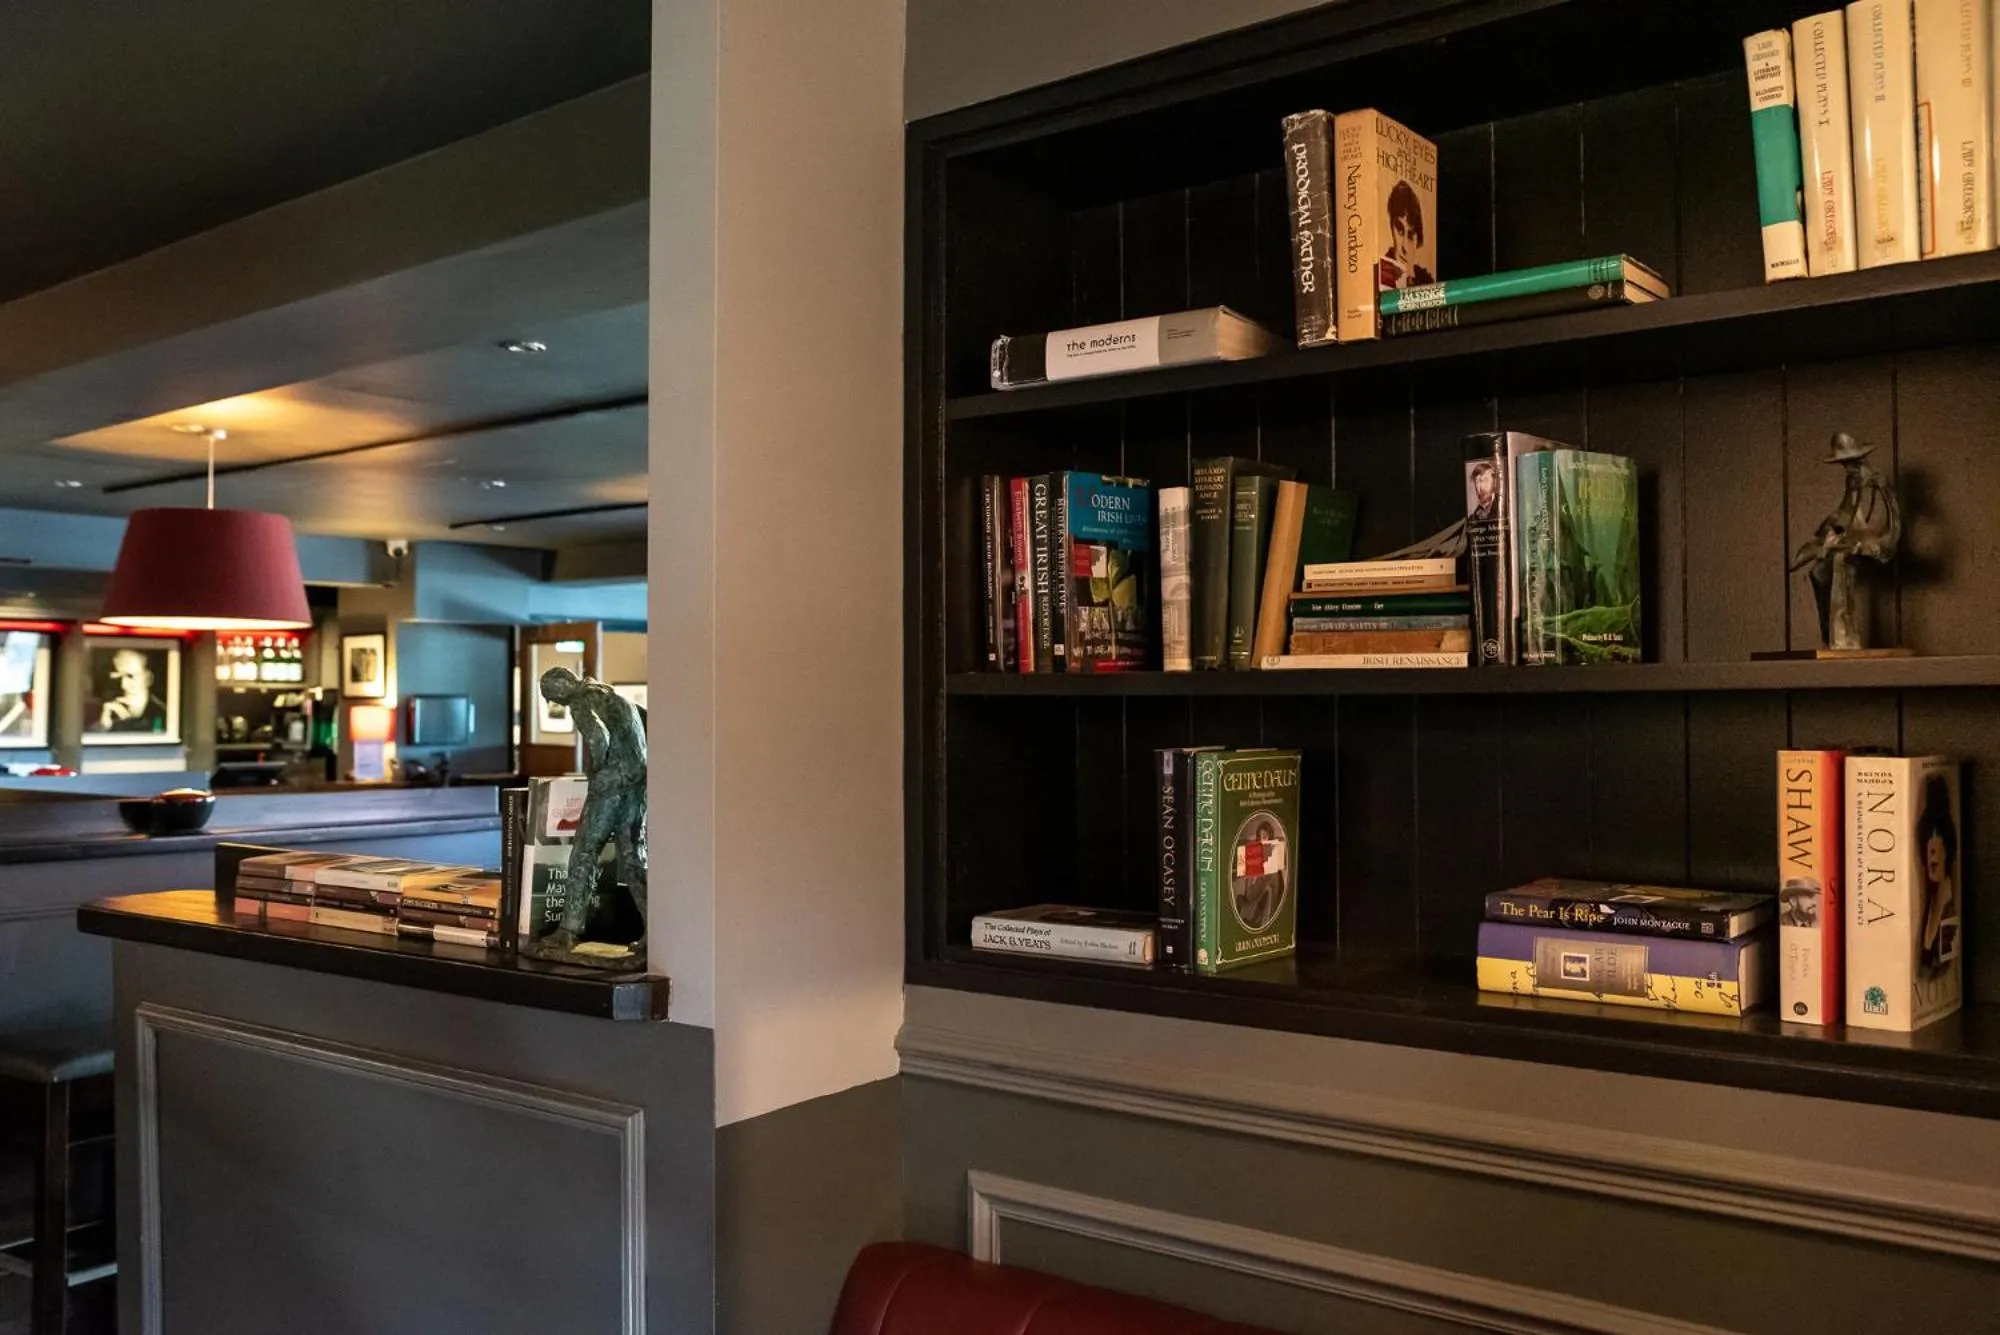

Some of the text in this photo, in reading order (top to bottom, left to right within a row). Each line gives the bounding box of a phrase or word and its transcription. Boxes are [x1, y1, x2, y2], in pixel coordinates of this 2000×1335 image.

[1344, 164, 1362, 211] Nancy
[1347, 213, 1364, 273] Cardozo
[1089, 333, 1137, 349] moderns
[1034, 483, 1048, 544] GREAT
[1098, 510, 1123, 524] IRISH
[1036, 546, 1049, 595] IRISH
[1320, 622, 1347, 630] EDWARD
[1349, 621, 1378, 630] MARTYN
[1363, 655, 1464, 667] IRISH RENAISSANCE
[1223, 768, 1298, 792] CELTIC DAWN
[1857, 770, 1893, 778] BRENDA
[1857, 777, 1893, 785] MADDOX
[1785, 768, 1813, 870] SHAW
[1856, 800, 1864, 856] BIOGRAPHY
[1867, 791, 1896, 924] NORA
[548, 867, 569, 880] Tha
[1162, 835, 1177, 907] O'CASEY
[546, 883, 567, 896] May
[1856, 872, 1864, 897] NORA
[546, 896, 566, 909] the
[1500, 902, 1606, 927] The Pear Is Ripe
[983, 922, 997, 931] The
[1027, 926, 1045, 937] Plays
[1613, 916, 1691, 932] JOHN MONTAGUE
[983, 934, 1008, 945] JACK
[1018, 937, 1052, 950] YEATS
